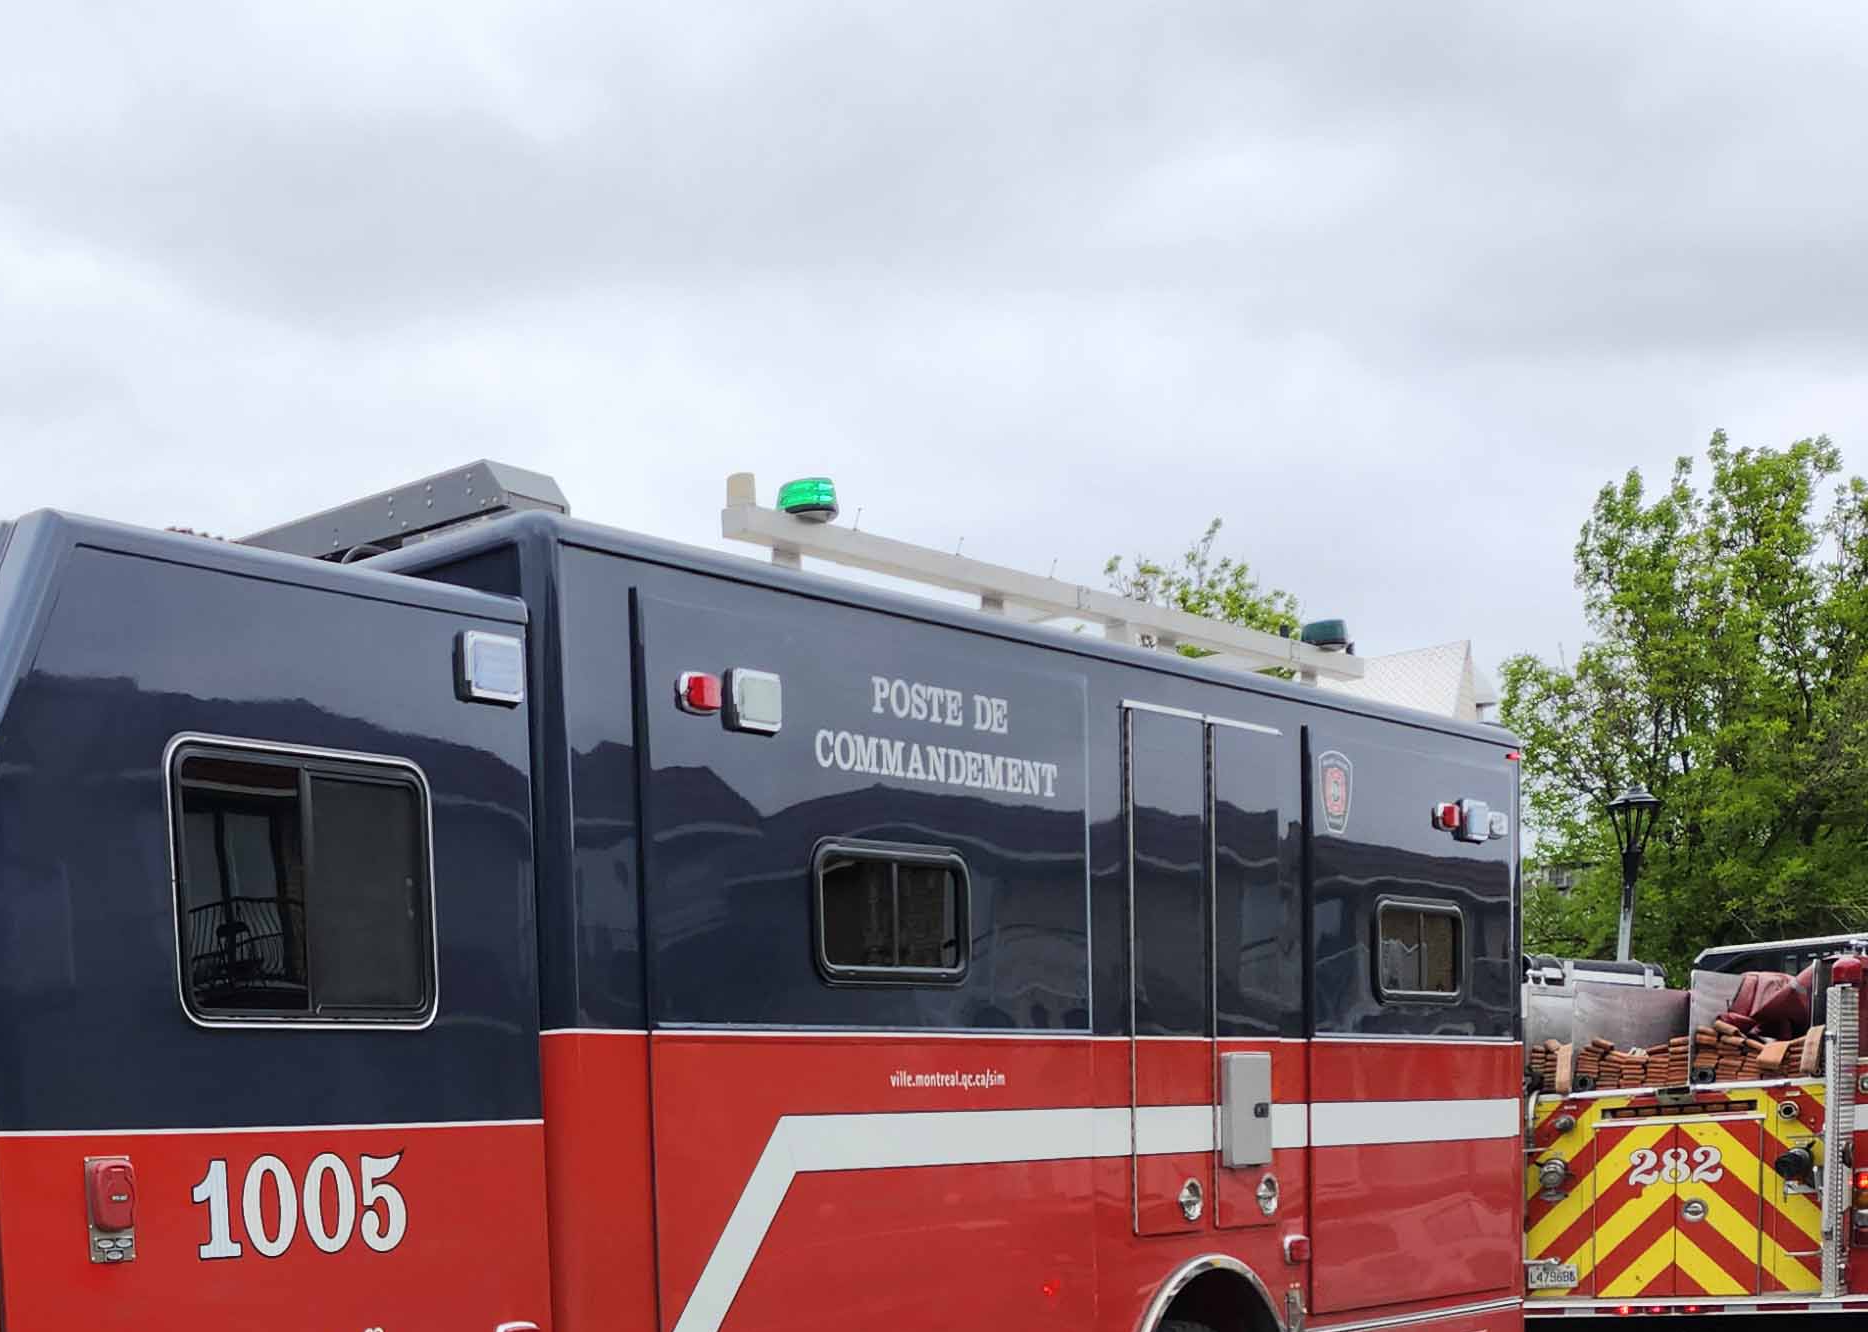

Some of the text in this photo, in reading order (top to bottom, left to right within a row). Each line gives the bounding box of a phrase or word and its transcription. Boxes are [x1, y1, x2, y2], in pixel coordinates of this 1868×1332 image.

[871, 675, 1009, 734] POSTE DE
[815, 728, 1058, 798] COMMANDEMENT
[890, 1068, 1006, 1091] ville.montreal.qc.ca/sim
[1628, 1144, 1724, 1187] 282
[191, 1147, 408, 1260] 1005
